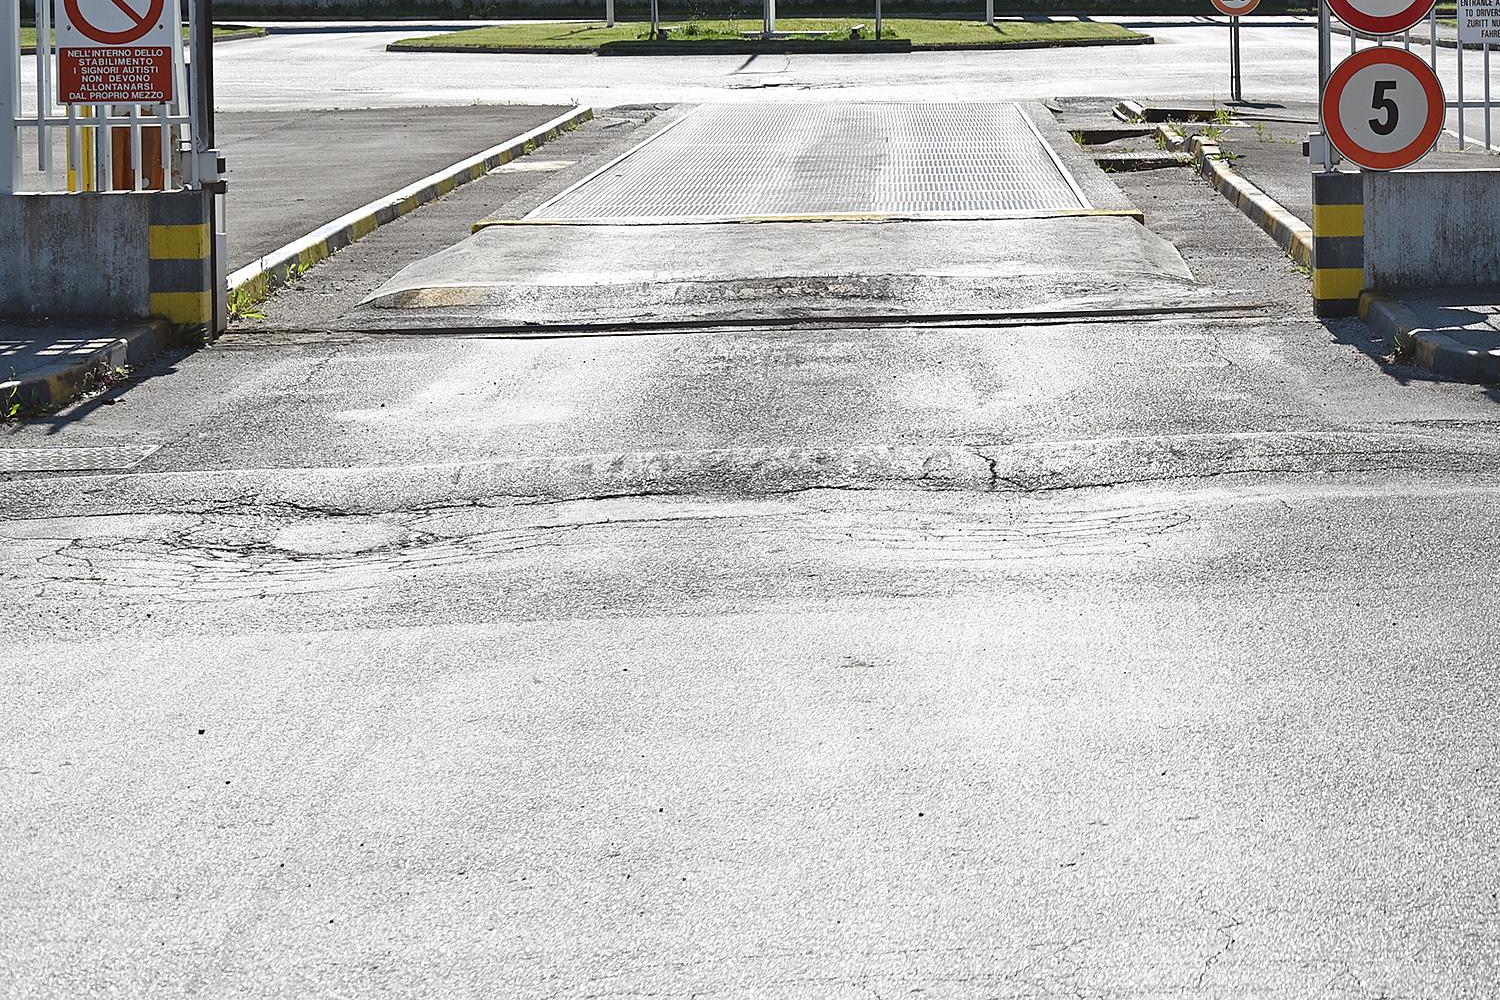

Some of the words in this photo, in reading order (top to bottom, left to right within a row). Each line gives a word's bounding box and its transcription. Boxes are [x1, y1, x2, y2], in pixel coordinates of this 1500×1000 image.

[1466, 9, 1473, 17] TO
[68, 49, 131, 57] NELL'INTERNO
[79, 58, 153, 66] STABILIMENTO
[122, 66, 158, 74] AUTISTI
[80, 83, 154, 91] ALLONTANARSI
[132, 91, 163, 99] MEZZO
[1369, 80, 1399, 136] 5
